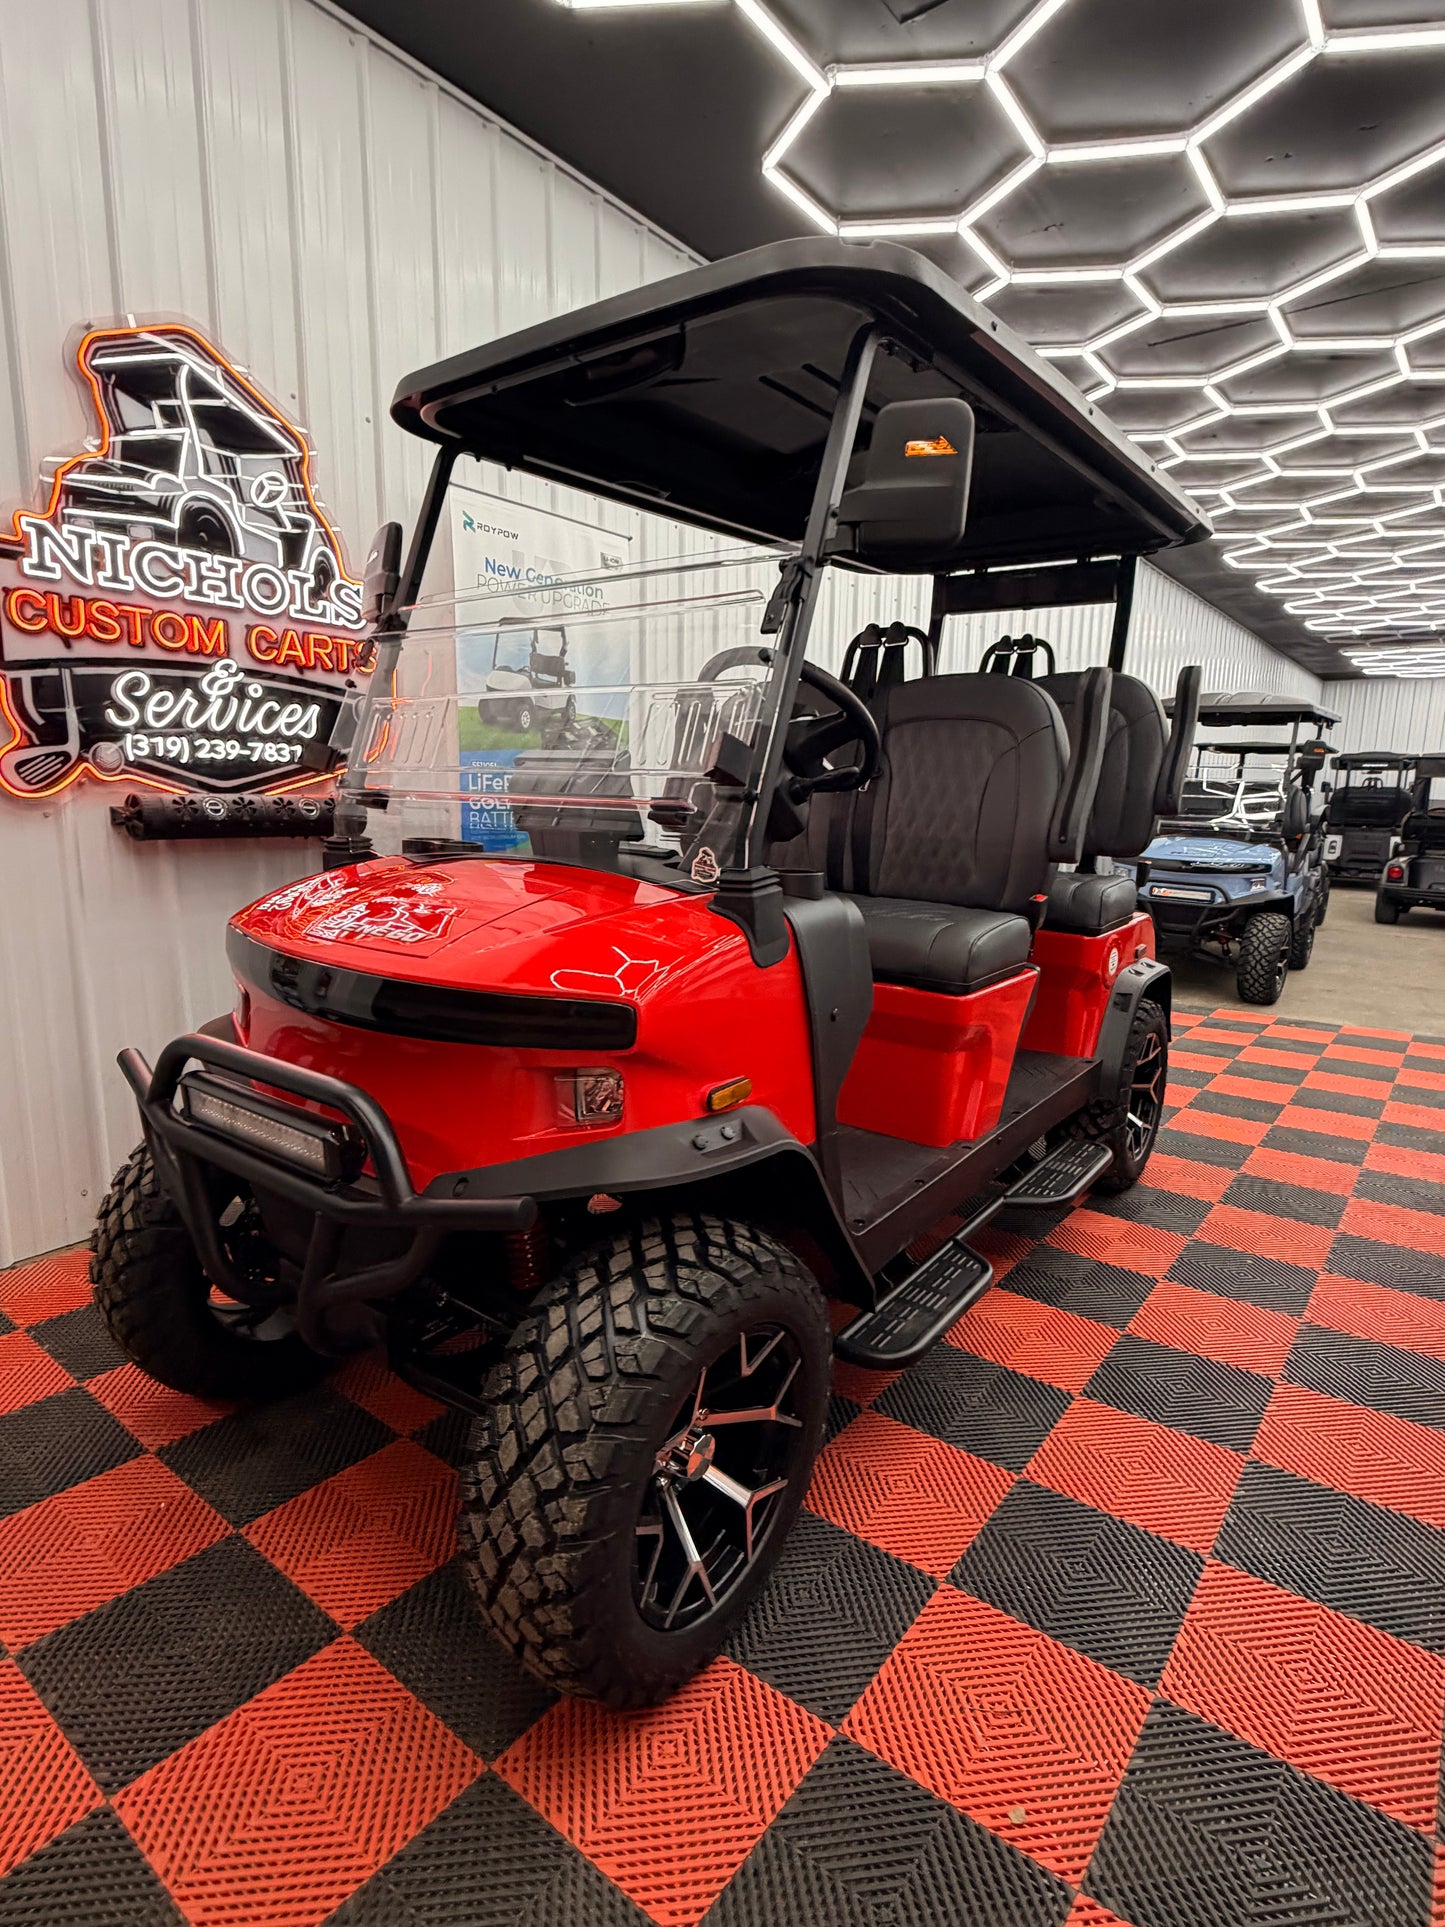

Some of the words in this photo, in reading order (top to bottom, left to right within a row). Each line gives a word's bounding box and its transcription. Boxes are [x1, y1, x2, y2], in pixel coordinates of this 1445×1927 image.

[477, 522, 519, 540] ROYPOW
[20, 516, 366, 629] NICHOLS
[484, 557, 521, 579] New
[6, 587, 229, 656] CUSTOM
[247, 625, 378, 675] CARTS
[201, 659, 244, 699] &
[105, 670, 320, 738] Services
[124, 733, 190, 762] (319)
[193, 737, 303, 764] 239-7831
